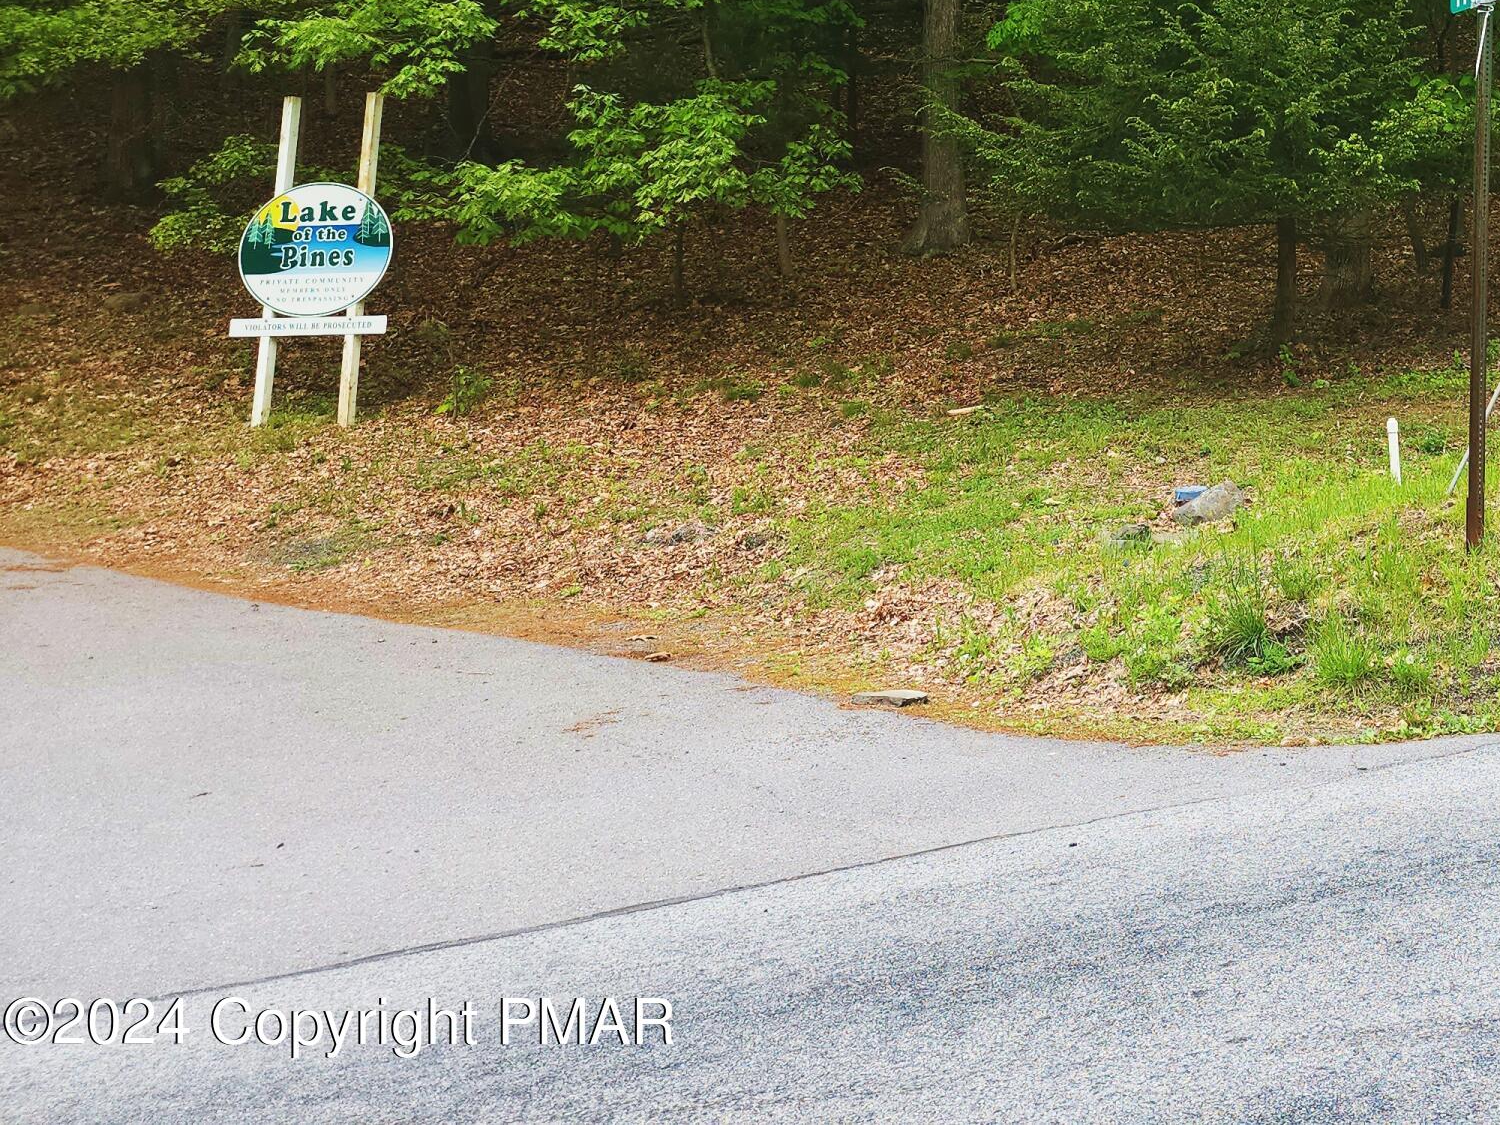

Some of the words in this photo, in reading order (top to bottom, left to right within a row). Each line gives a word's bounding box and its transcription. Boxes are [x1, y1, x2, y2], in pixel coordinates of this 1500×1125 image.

[280, 201, 356, 223] Lake
[293, 228, 311, 242] of
[318, 227, 346, 241] the
[281, 246, 354, 268] Pines
[260, 278, 299, 286] PRIVATE
[305, 277, 365, 285] COMMUNITY
[291, 295, 349, 303] TRESPASSING
[244, 323, 287, 331] VIOLATORS
[289, 322, 308, 330] WILL
[310, 322, 321, 330] BE
[323, 321, 372, 329] PROSECUTED
